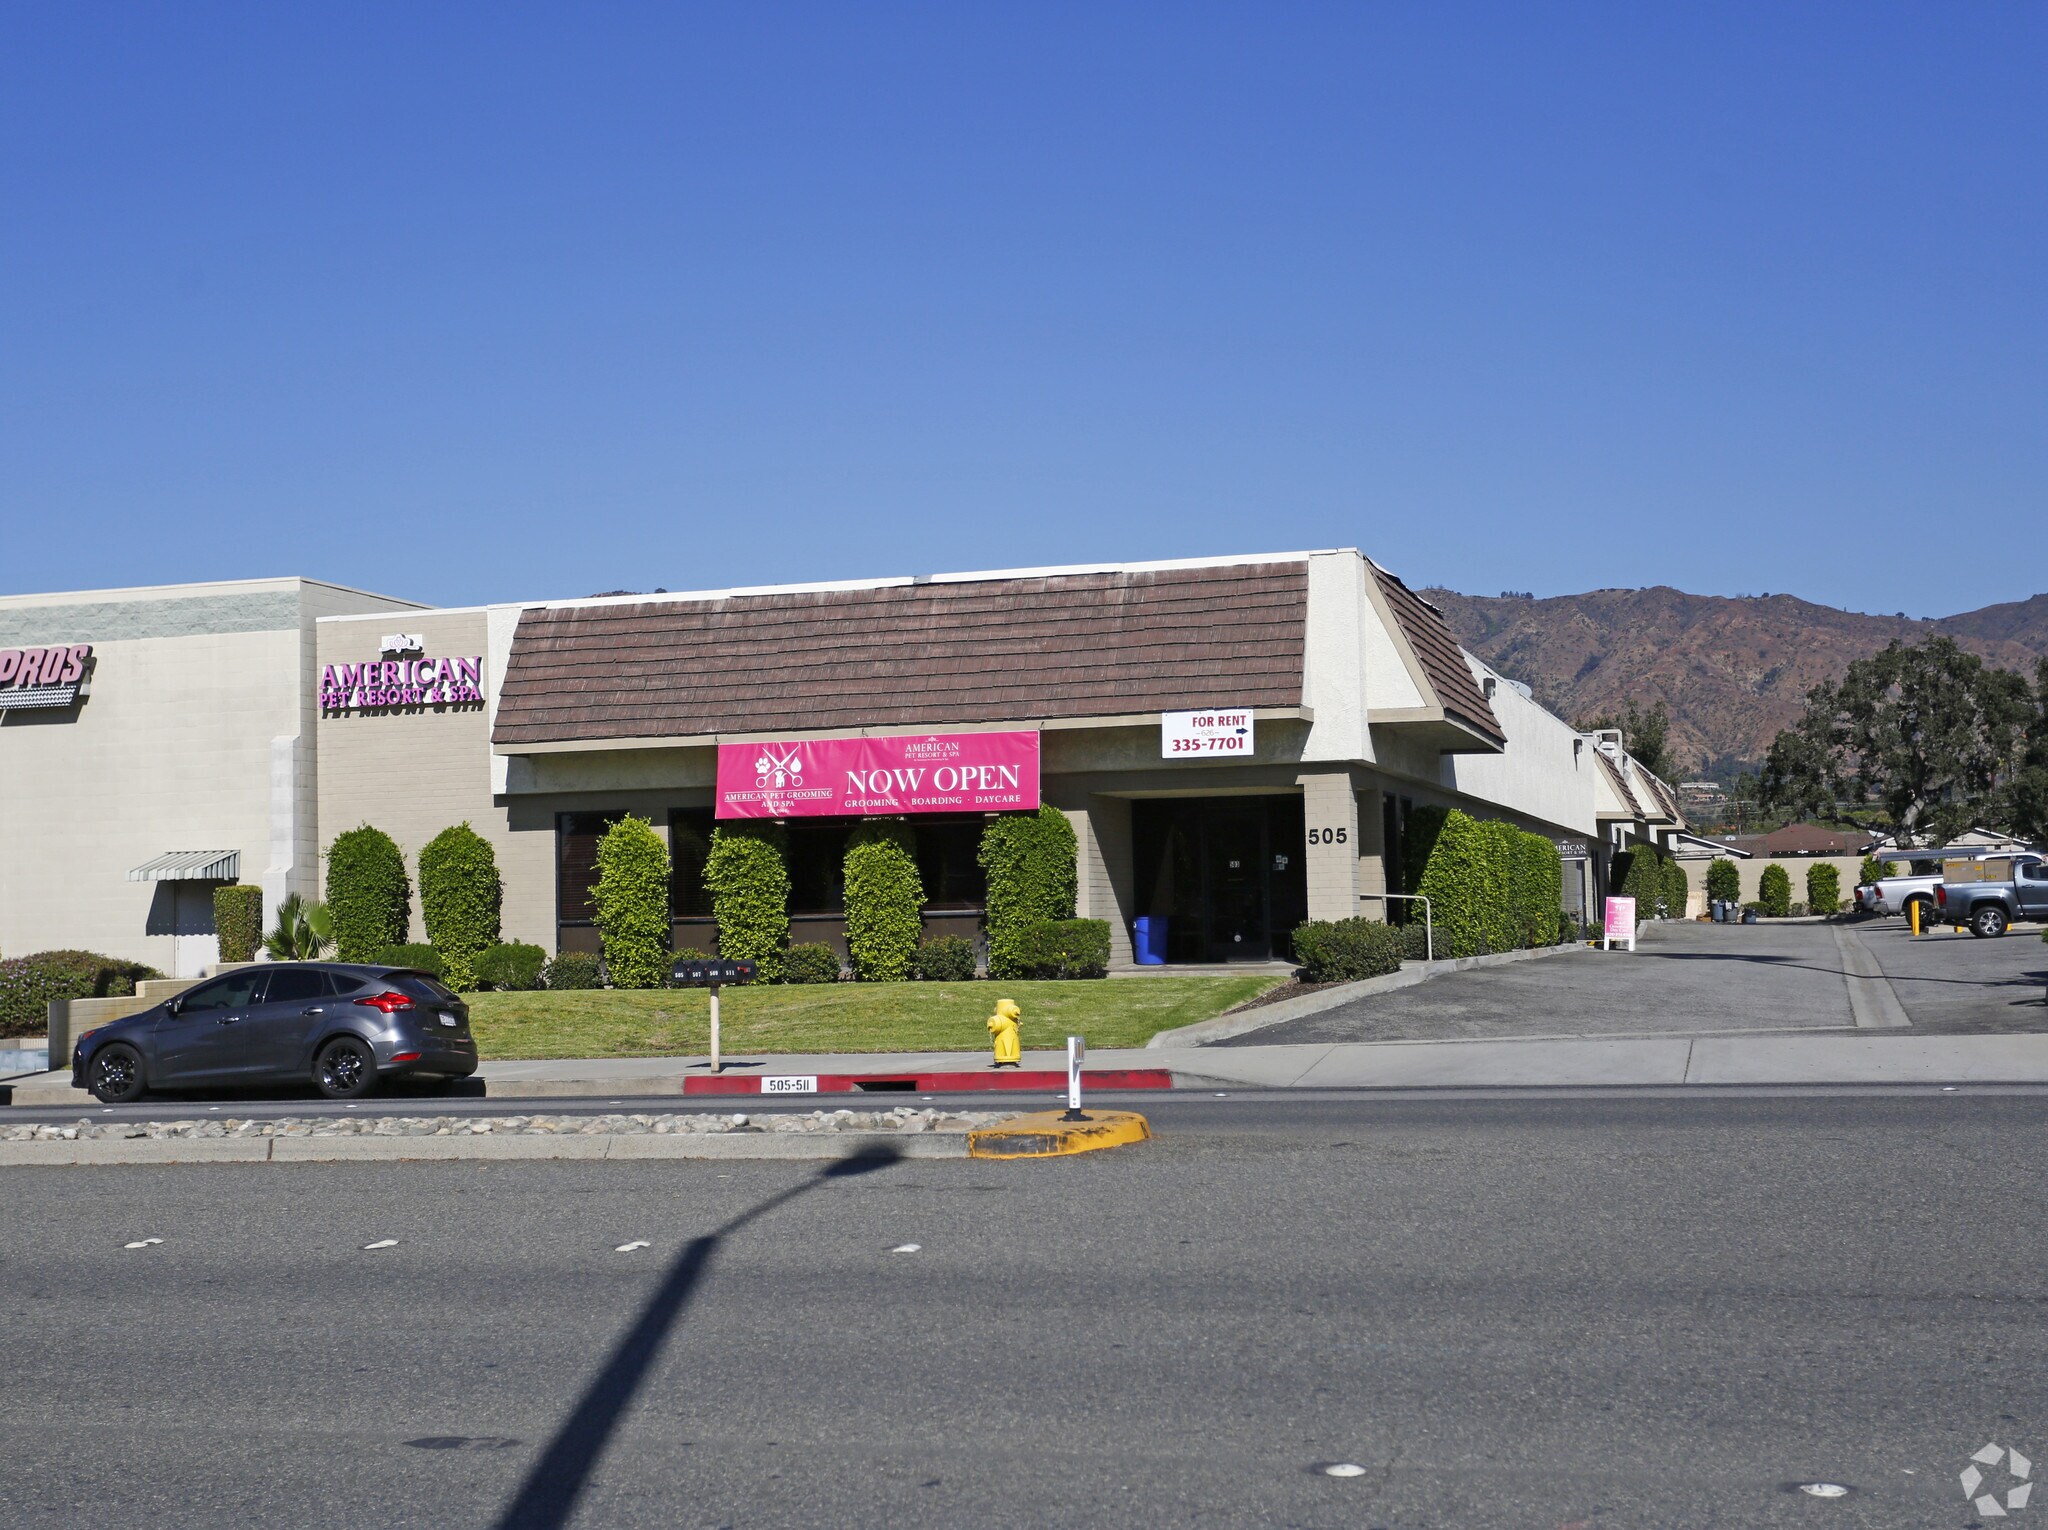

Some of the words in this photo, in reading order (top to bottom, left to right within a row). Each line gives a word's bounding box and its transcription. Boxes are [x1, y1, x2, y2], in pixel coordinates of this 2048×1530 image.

[0, 645, 89, 685] PROS
[320, 656, 482, 690] AMERICAN
[319, 691, 349, 709] PET
[356, 687, 424, 706] RESORT
[431, 687, 442, 702] &
[450, 684, 481, 701] SPA
[1192, 717, 1214, 728] FOR
[1218, 715, 1246, 727] RENT
[1201, 729, 1214, 737] 626
[905, 742, 959, 753] AMERICAN
[1172, 737, 1243, 752] 335-7701
[845, 768, 926, 794] NOW
[933, 765, 1020, 791] OPEN
[724, 793, 767, 801] AMERICAN
[786, 790, 833, 799] GROOMING
[844, 799, 899, 808] GROOMING
[911, 796, 963, 805] BOARDING
[975, 794, 1021, 804] DAYCARE
[1308, 827, 1347, 845] 505
[769, 1079, 809, 1091] 505-511
